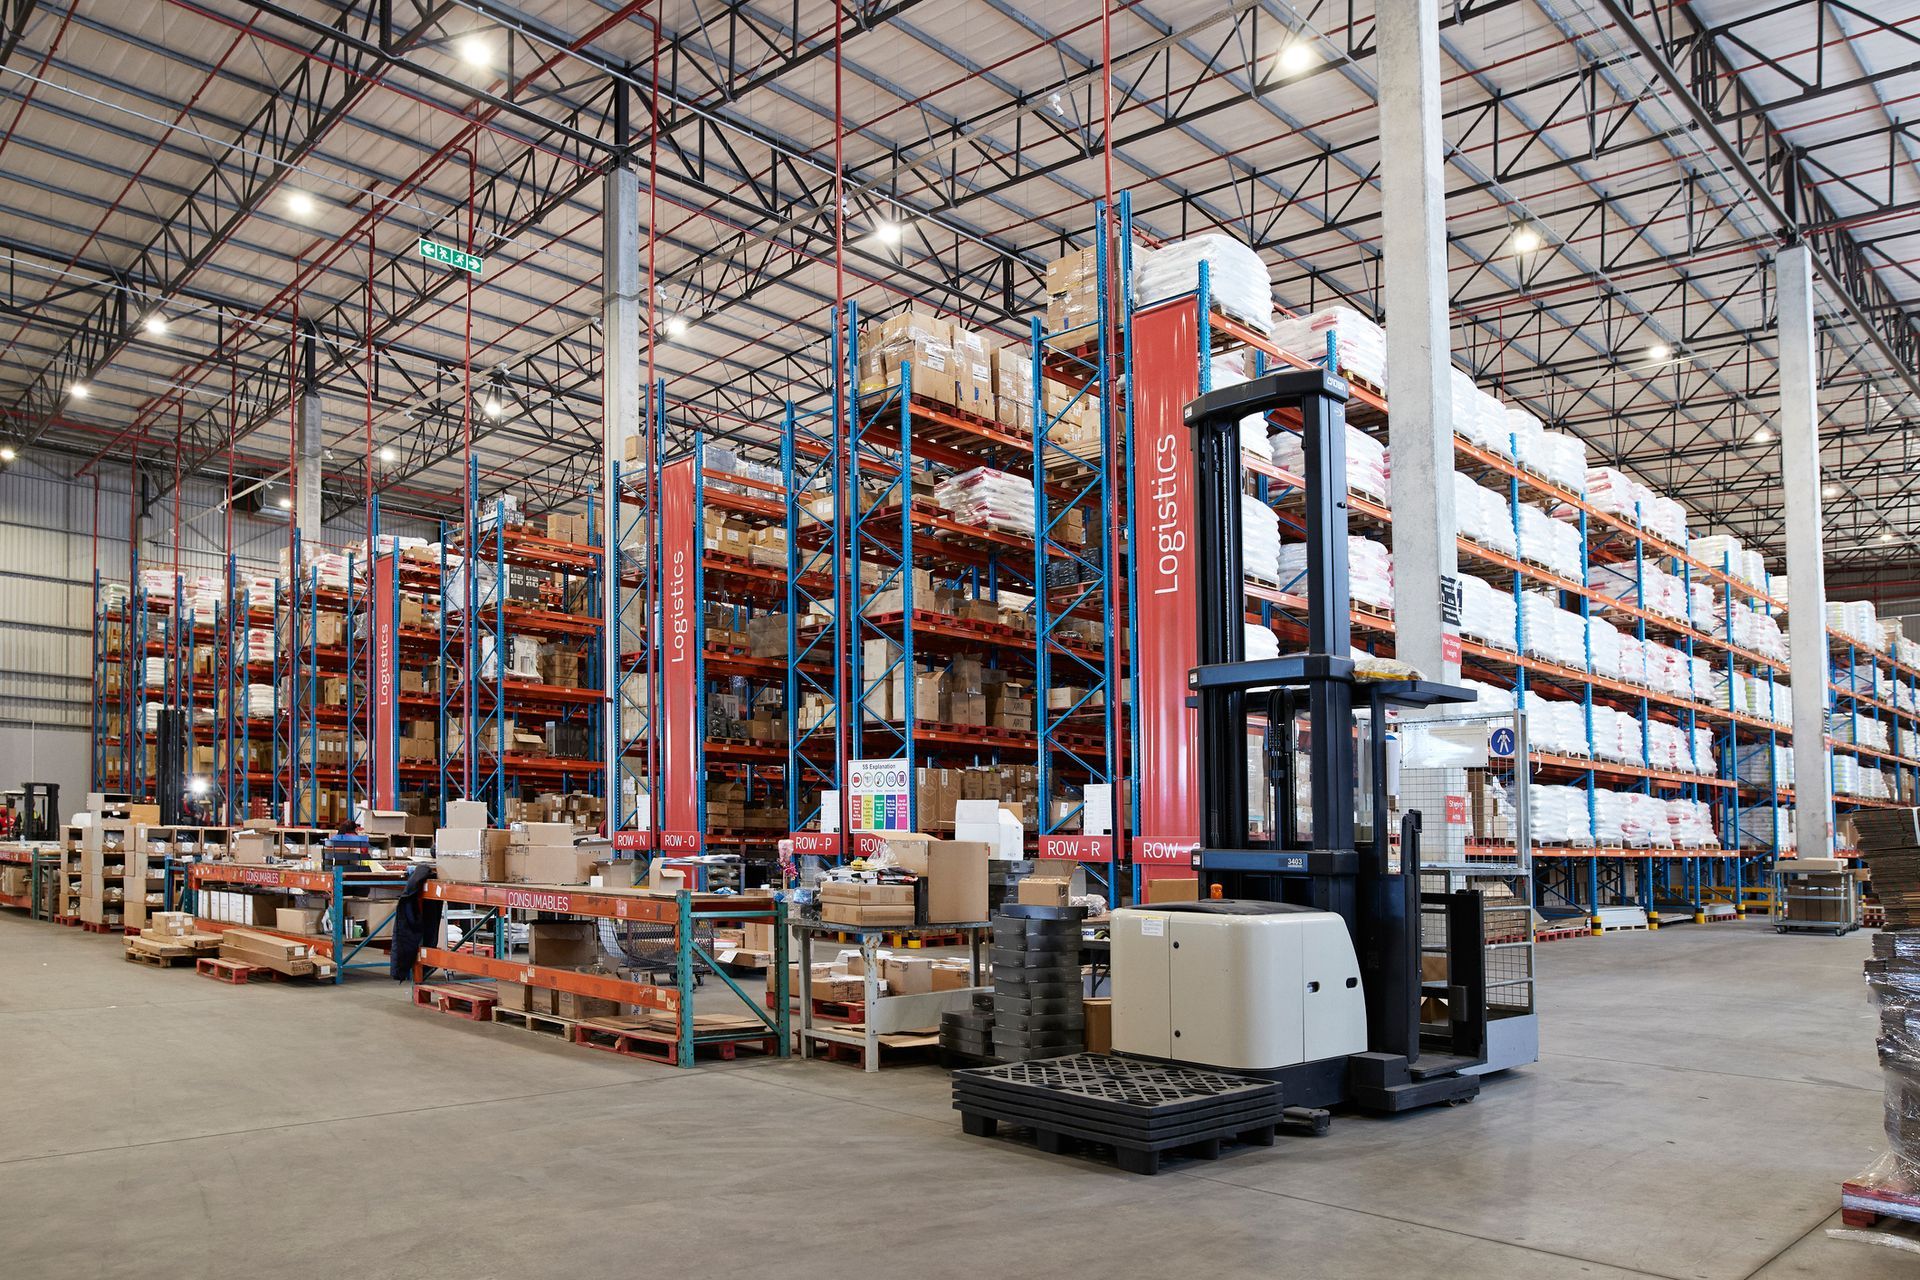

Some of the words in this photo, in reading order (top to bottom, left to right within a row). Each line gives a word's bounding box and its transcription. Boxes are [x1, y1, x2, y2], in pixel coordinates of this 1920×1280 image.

[1151, 434, 1185, 595] Logistics
[670, 550, 688, 662] Logistics
[380, 624, 391, 705] Logistics
[869, 763, 896, 771] Explanation
[617, 835, 634, 847] ROW
[640, 835, 646, 847] N
[664, 835, 682, 847] ROW
[795, 836, 818, 850] ROW
[825, 838, 832, 851] P
[1047, 841, 1079, 856] ROW
[1091, 841, 1100, 856] R
[1143, 842, 1178, 858] ROW
[1287, 857, 1303, 865] 3403
[245, 870, 279, 884] CONSUMABLES
[508, 891, 569, 911] CONSUMABLES
